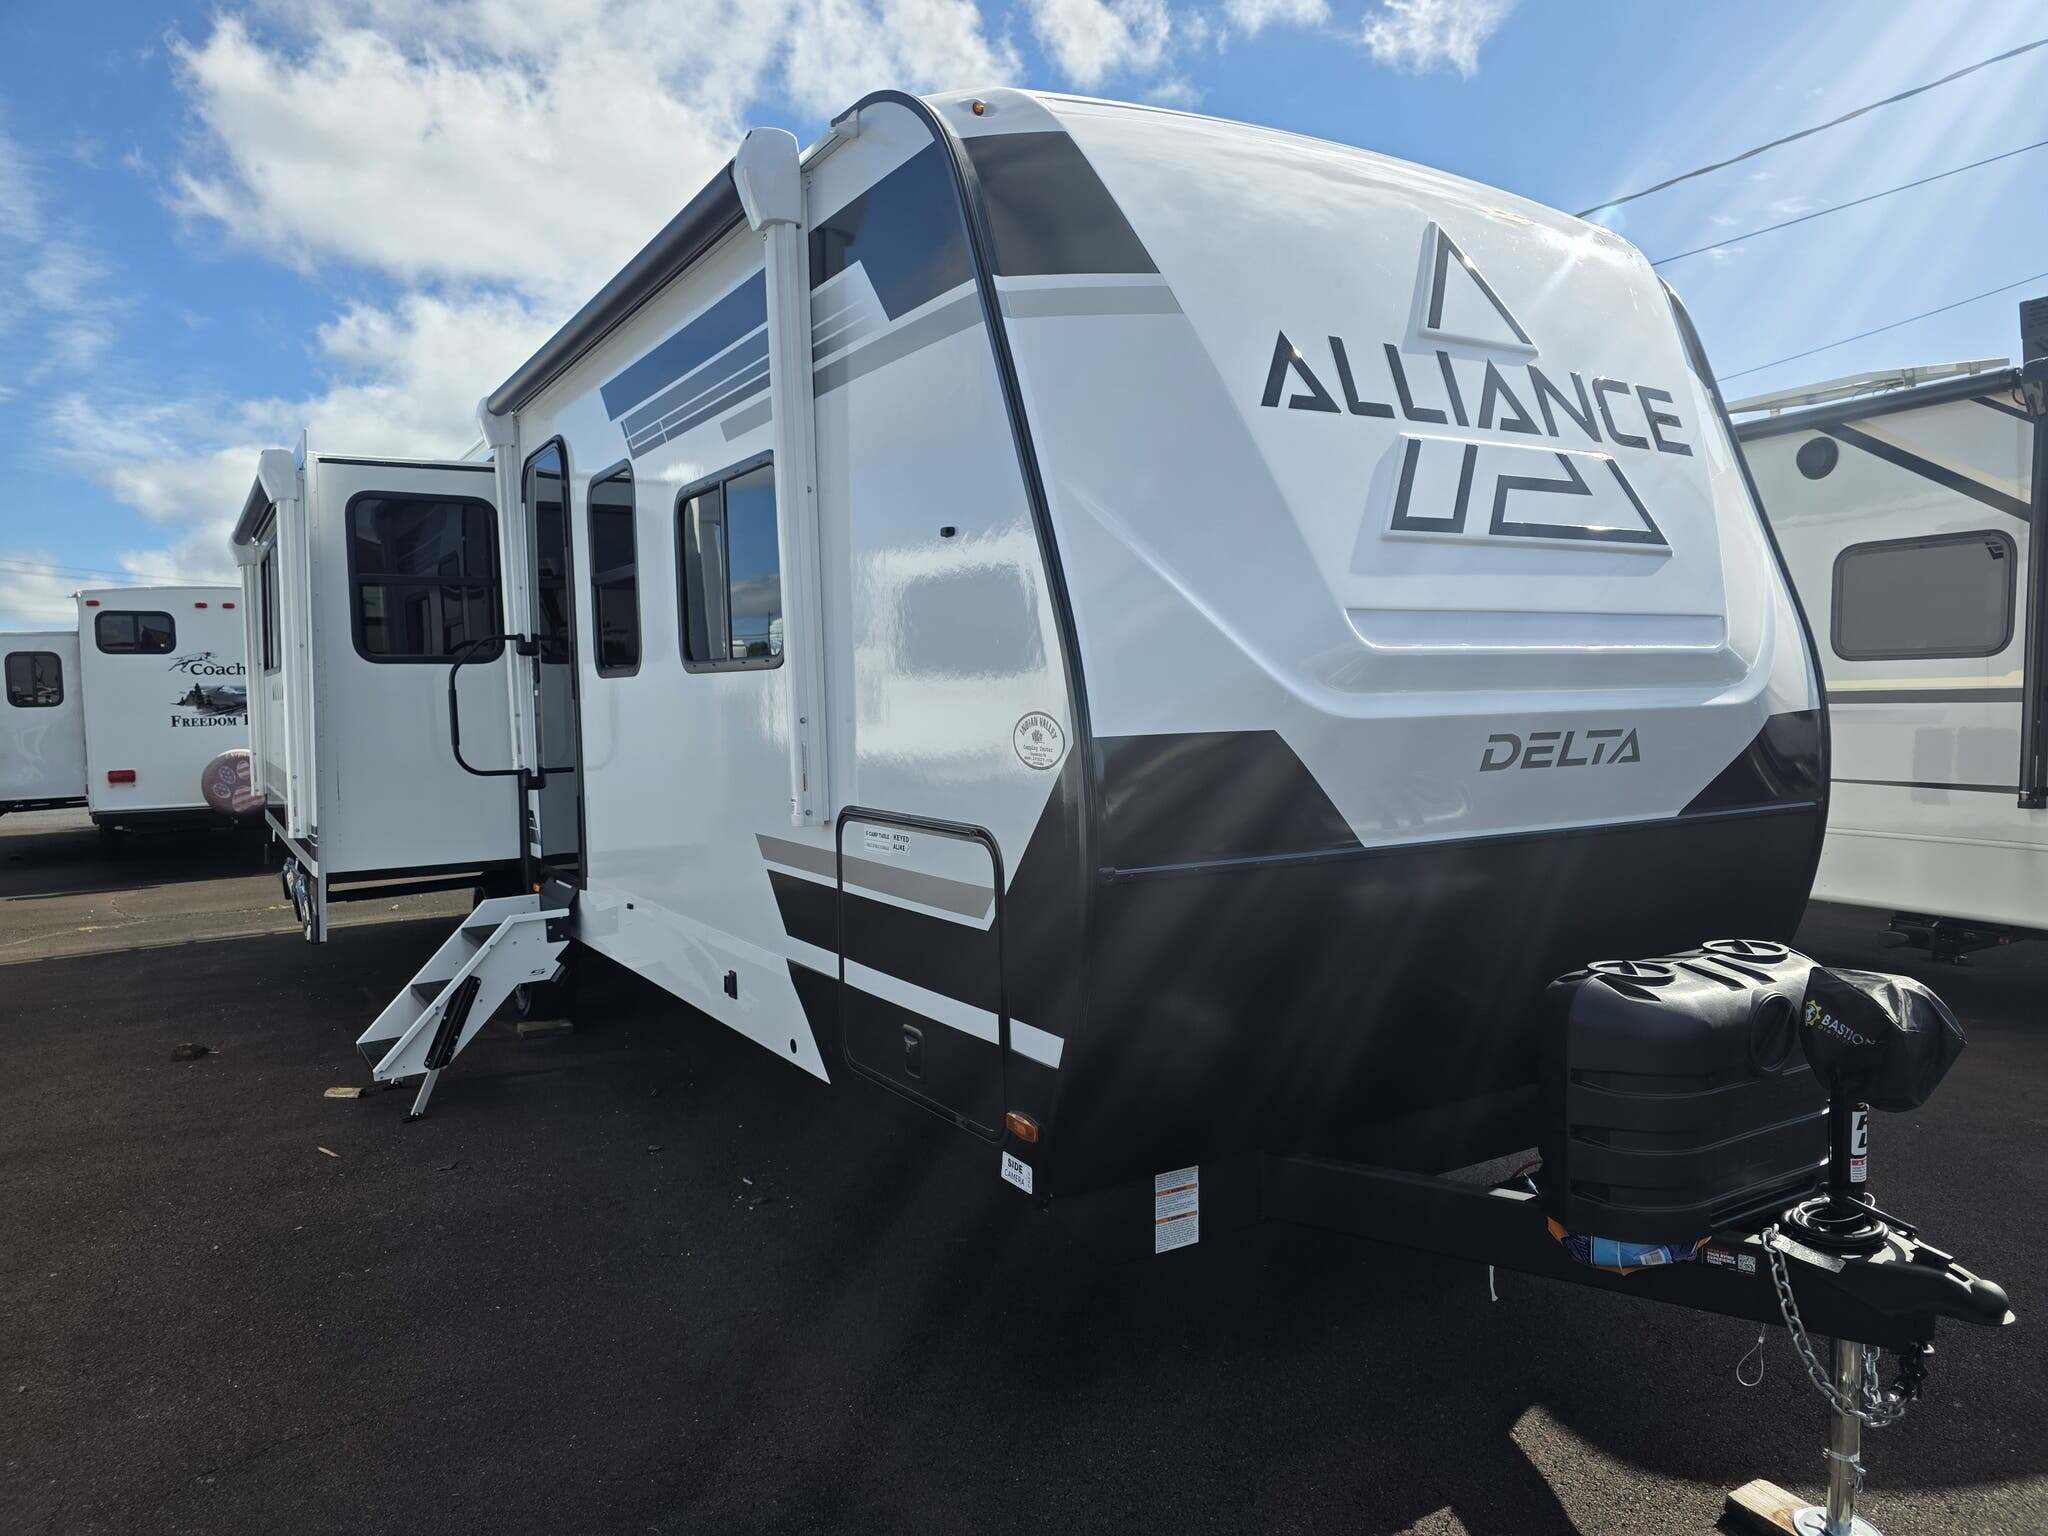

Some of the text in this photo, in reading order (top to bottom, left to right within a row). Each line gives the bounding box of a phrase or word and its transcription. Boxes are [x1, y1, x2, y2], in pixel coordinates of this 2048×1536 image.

[1261, 330, 1693, 457] ALLIANCE
[171, 715, 237, 727] FREEDOM
[1019, 715, 1057, 740] INDIAN VALLEY
[1479, 727, 1641, 772] DELTA
[893, 834, 909, 843] KEYED
[893, 843, 906, 852] ALIKE
[1008, 1158, 1023, 1174] SIDE
[1004, 1168, 1025, 1186] CAMERA
